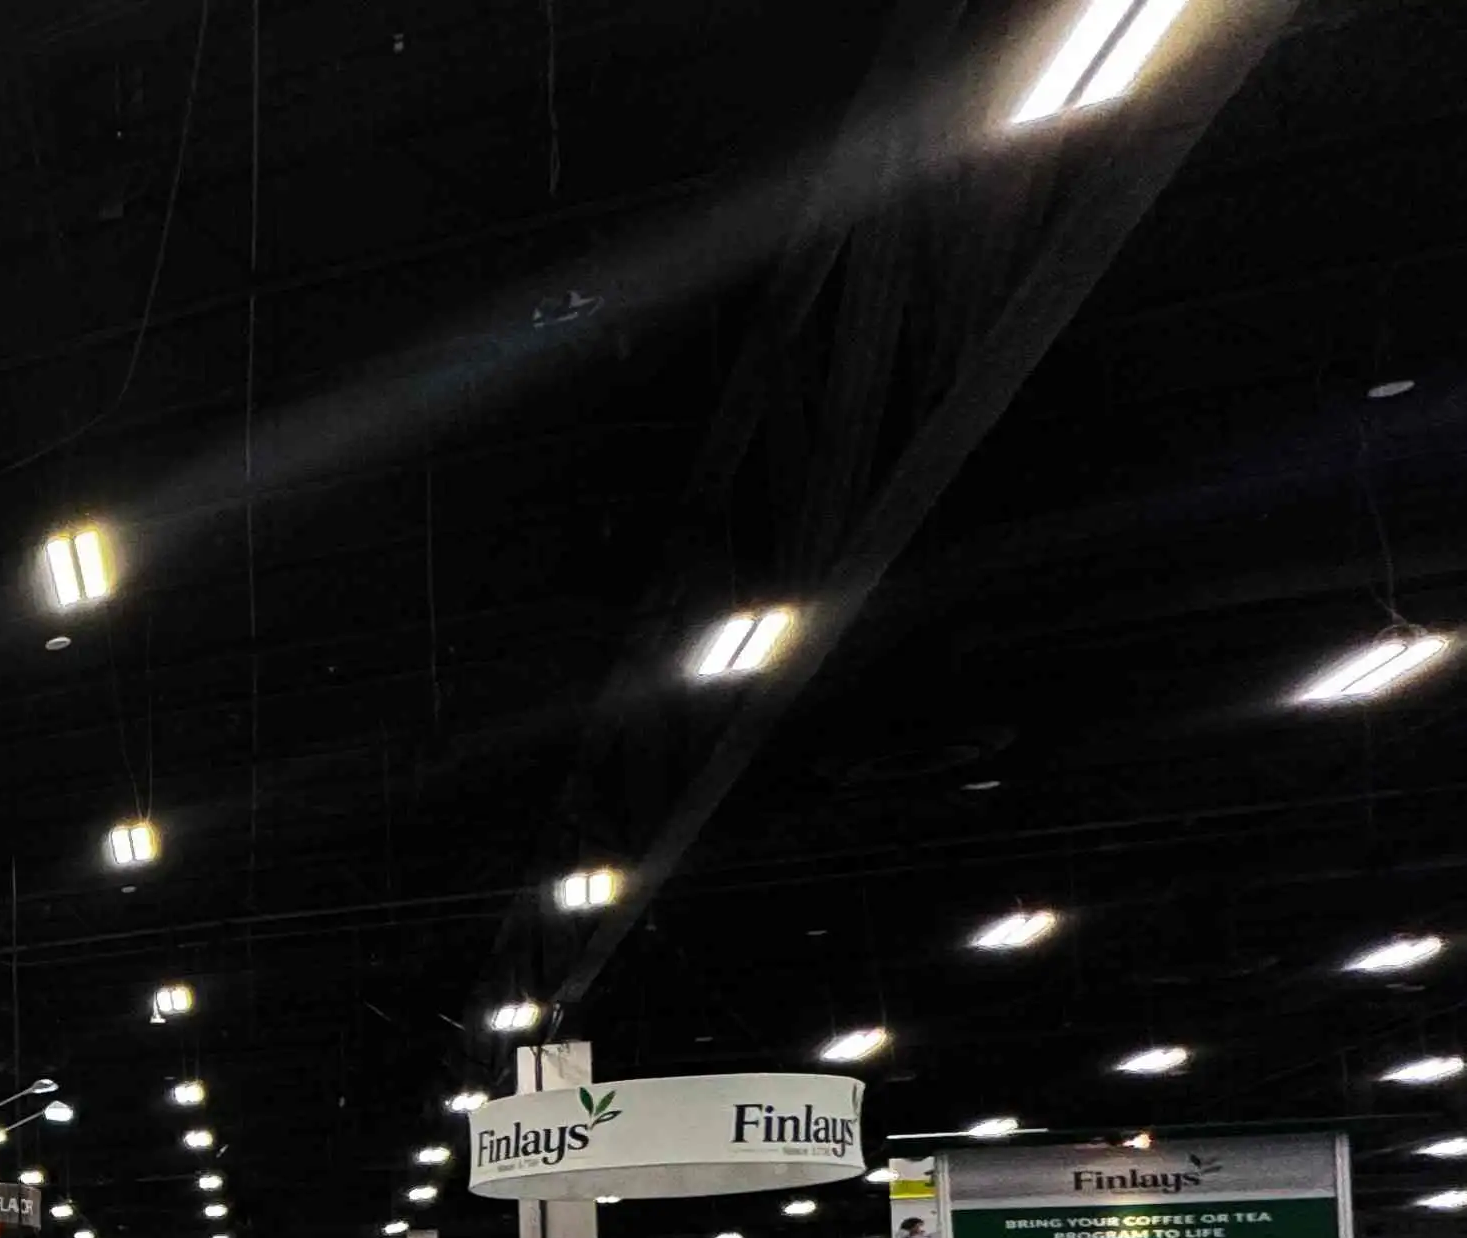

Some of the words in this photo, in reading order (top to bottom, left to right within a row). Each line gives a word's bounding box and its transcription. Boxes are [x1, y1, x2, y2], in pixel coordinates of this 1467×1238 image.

[732, 1103, 855, 1158] Finlays
[476, 1121, 591, 1168] Finlays
[1073, 1168, 1201, 1193] Finlays
[1005, 1218, 1062, 1230] BRING
[1067, 1216, 1120, 1228] YOUR
[1123, 1214, 1196, 1227] COFFEE
[1200, 1213, 1230, 1224] OR
[1233, 1211, 1272, 1223] TEA
[1185, 1227, 1226, 1238] LIFE
